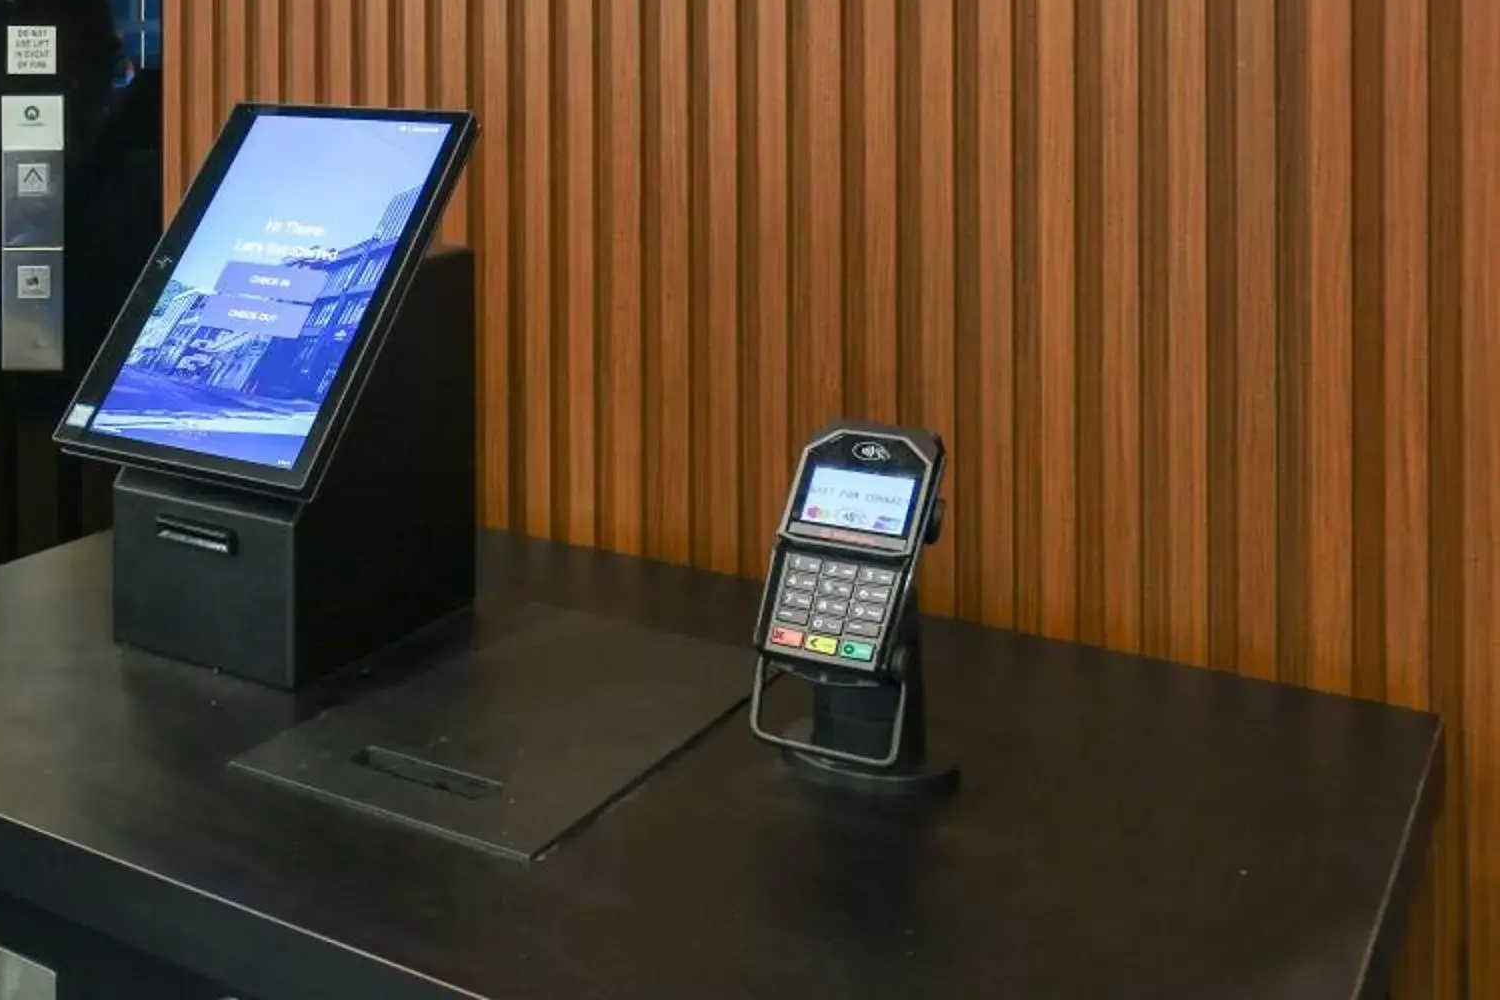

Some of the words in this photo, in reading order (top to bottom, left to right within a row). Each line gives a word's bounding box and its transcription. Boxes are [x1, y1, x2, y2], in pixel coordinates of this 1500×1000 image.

[248, 275, 278, 286] CHECK
[280, 279, 291, 288] IN
[228, 309, 256, 320] CHECK
[258, 313, 278, 322] OUT
